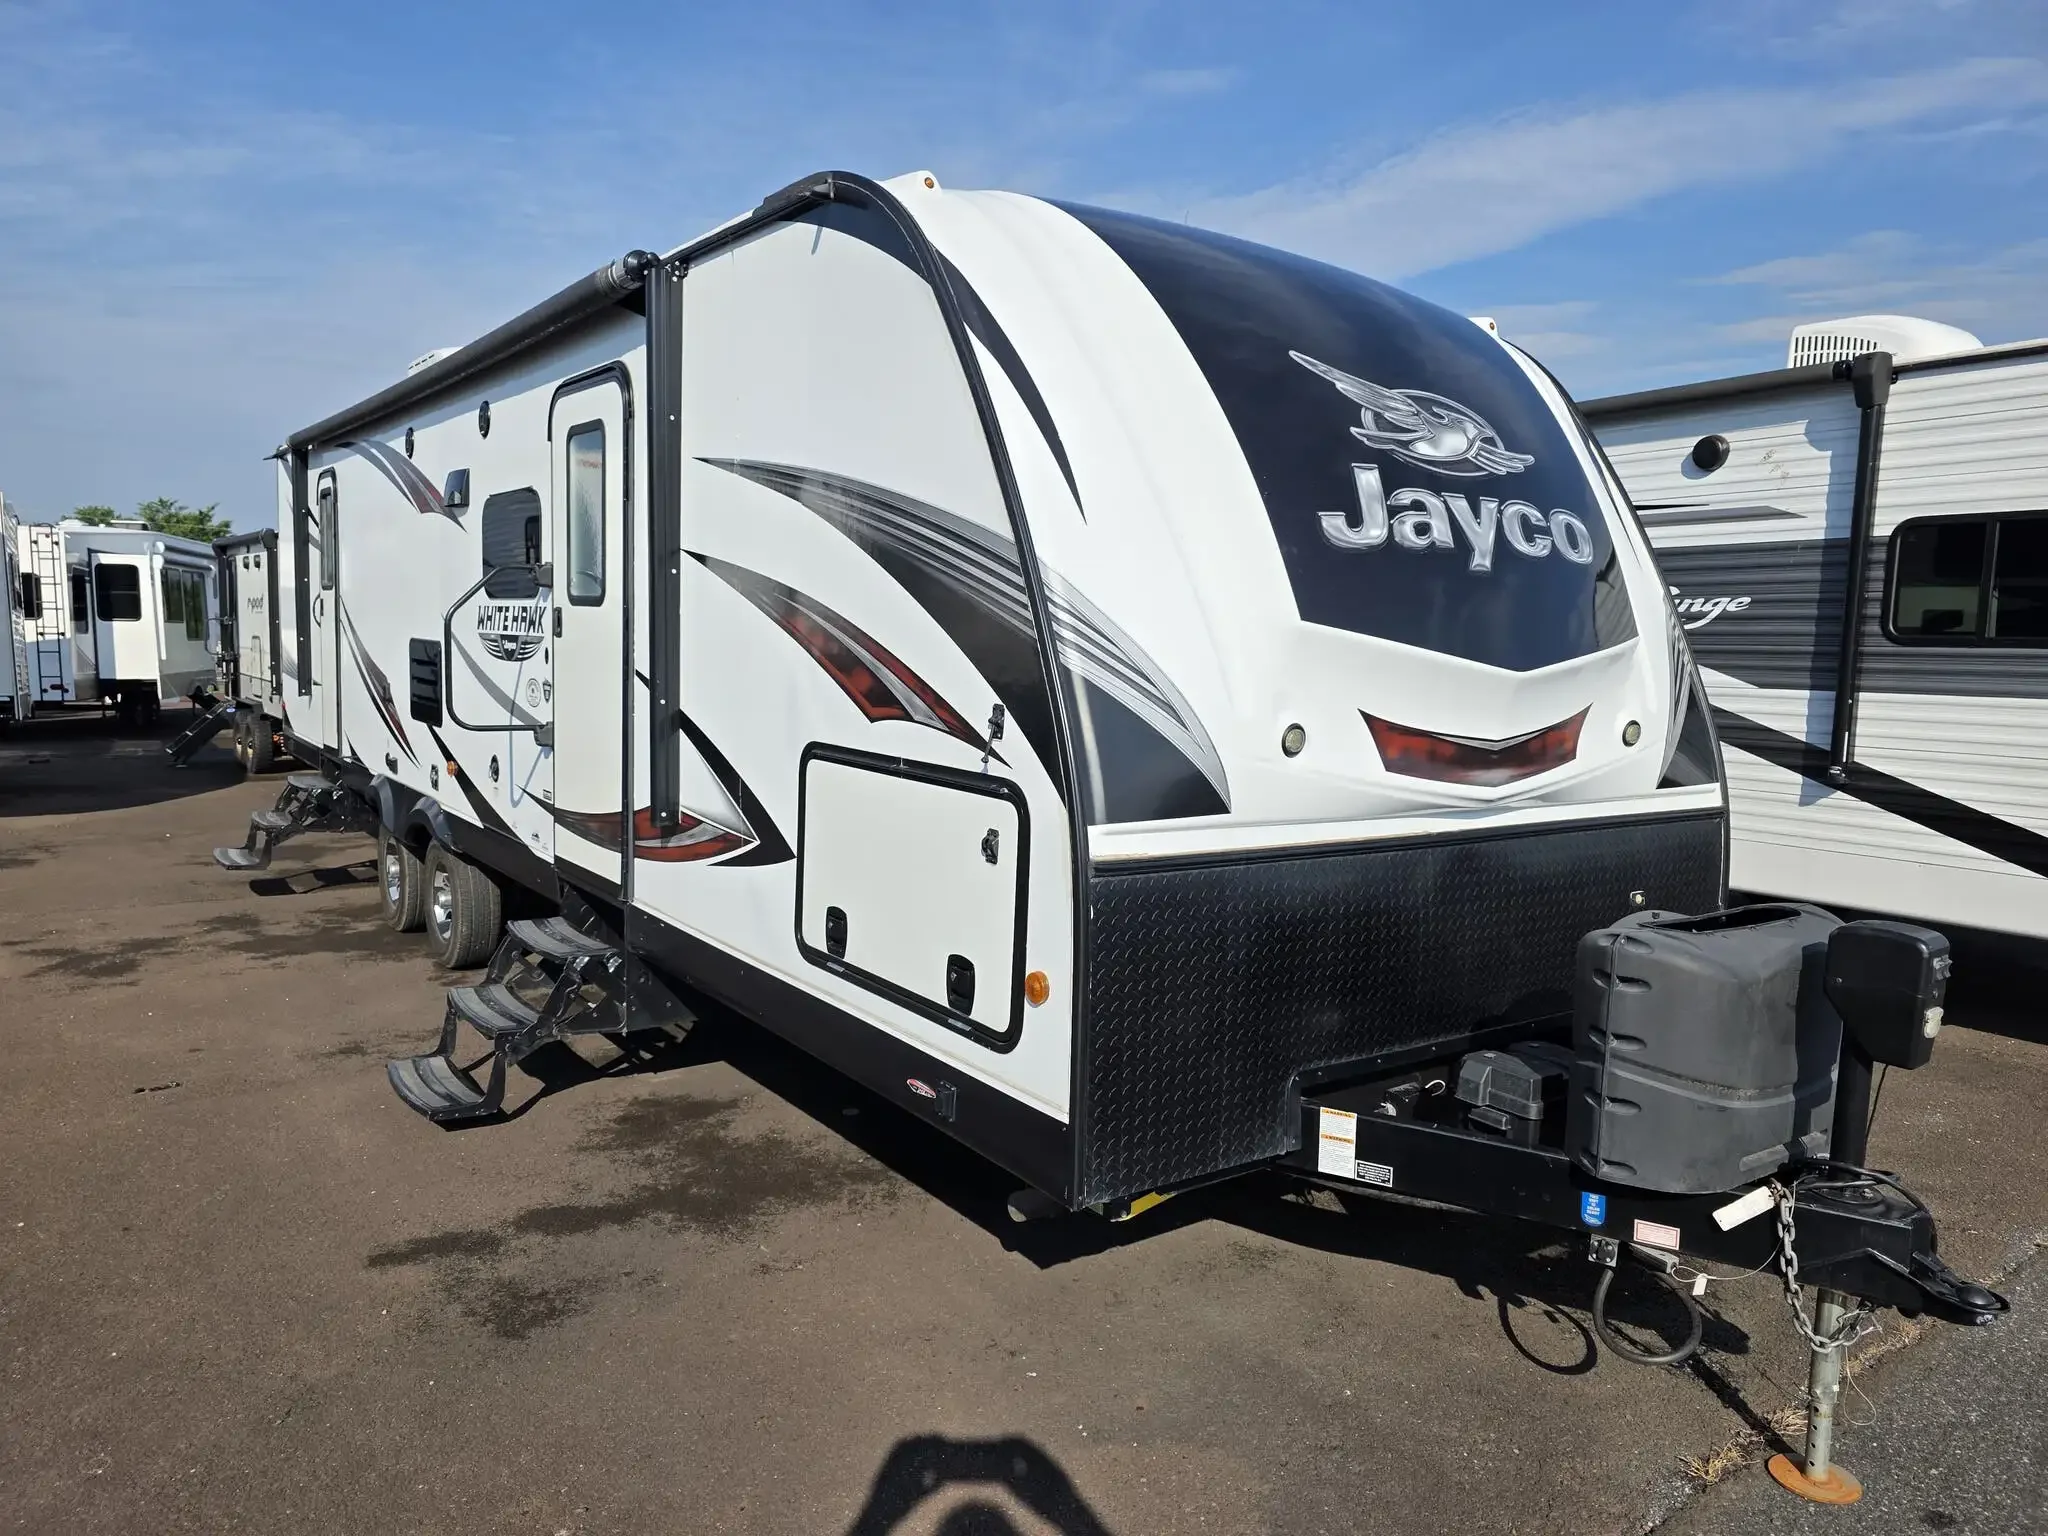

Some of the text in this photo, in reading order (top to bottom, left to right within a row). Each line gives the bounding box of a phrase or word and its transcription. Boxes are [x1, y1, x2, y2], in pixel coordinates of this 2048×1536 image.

[1317, 462, 1595, 577] Jayco
[477, 605, 547, 634] WHITE HAWK
